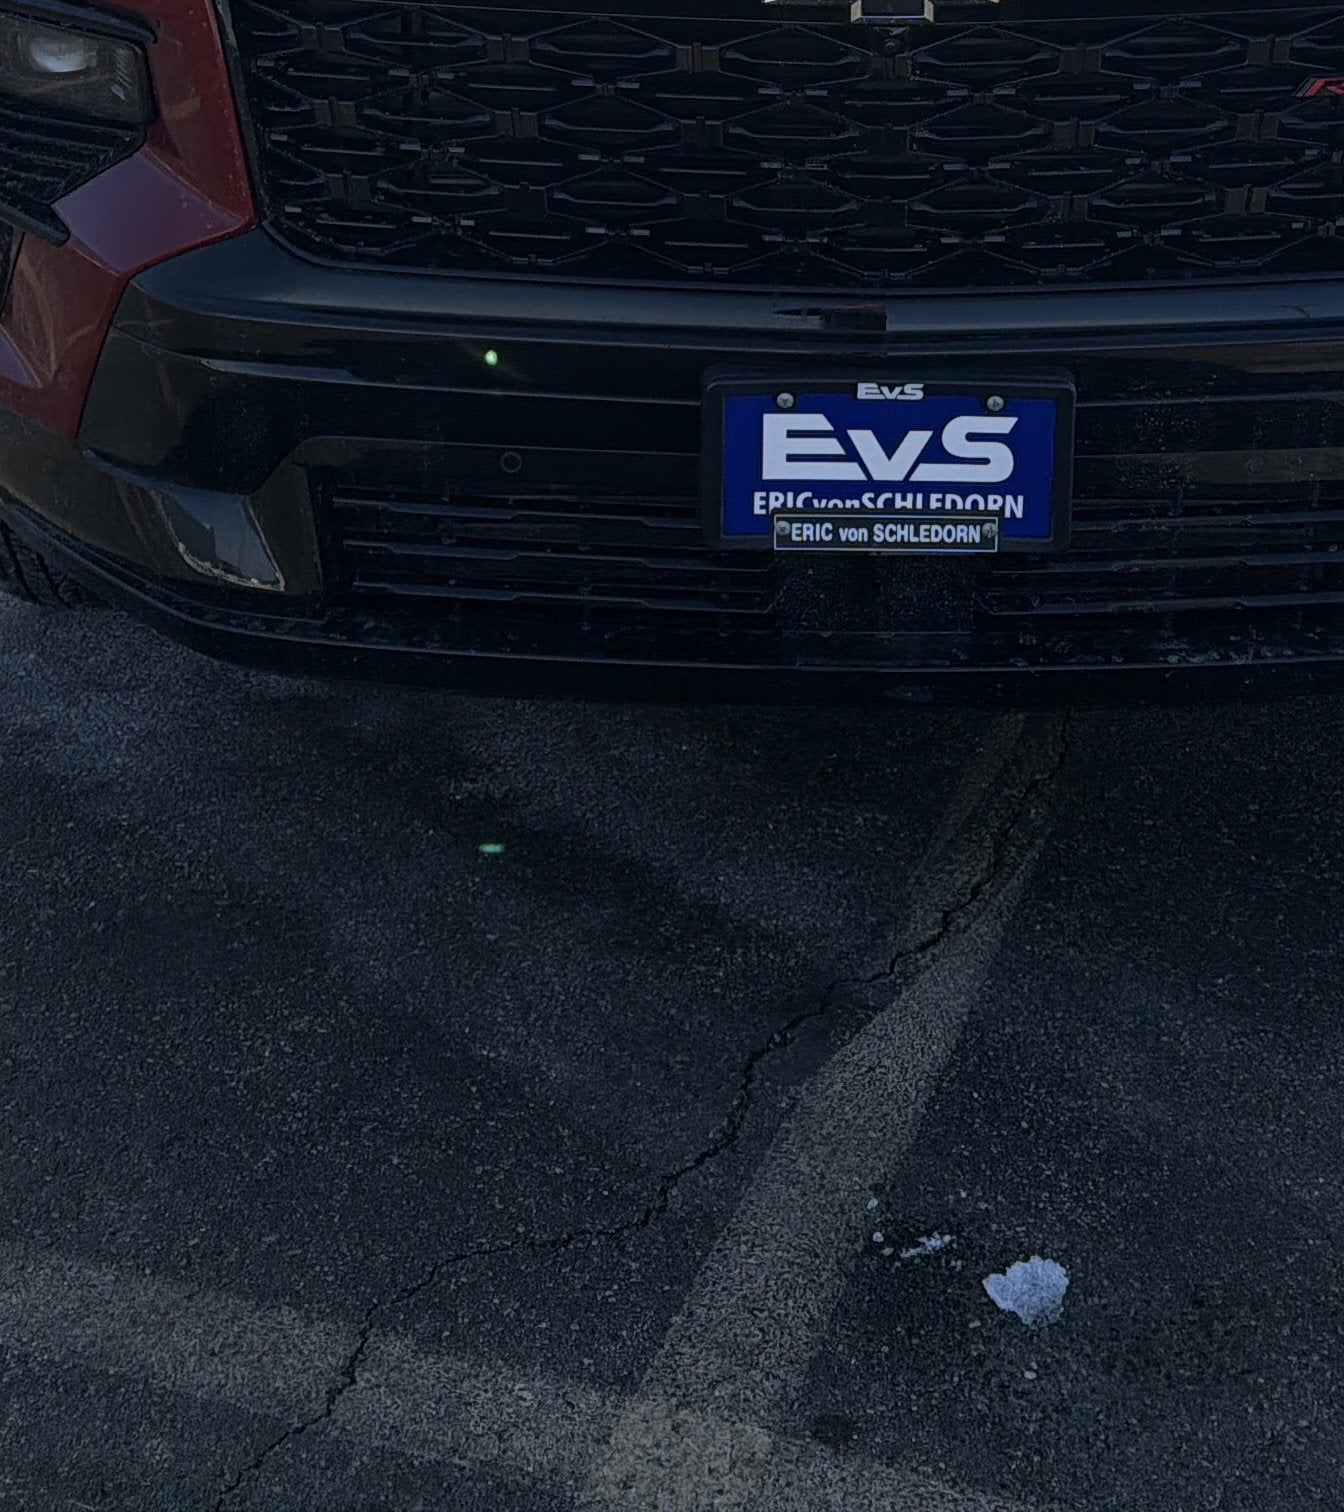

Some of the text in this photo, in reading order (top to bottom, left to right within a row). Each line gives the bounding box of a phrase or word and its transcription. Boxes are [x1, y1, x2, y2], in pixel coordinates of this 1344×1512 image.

[791, 522, 981, 543] ERIC von SCHLEDORN
